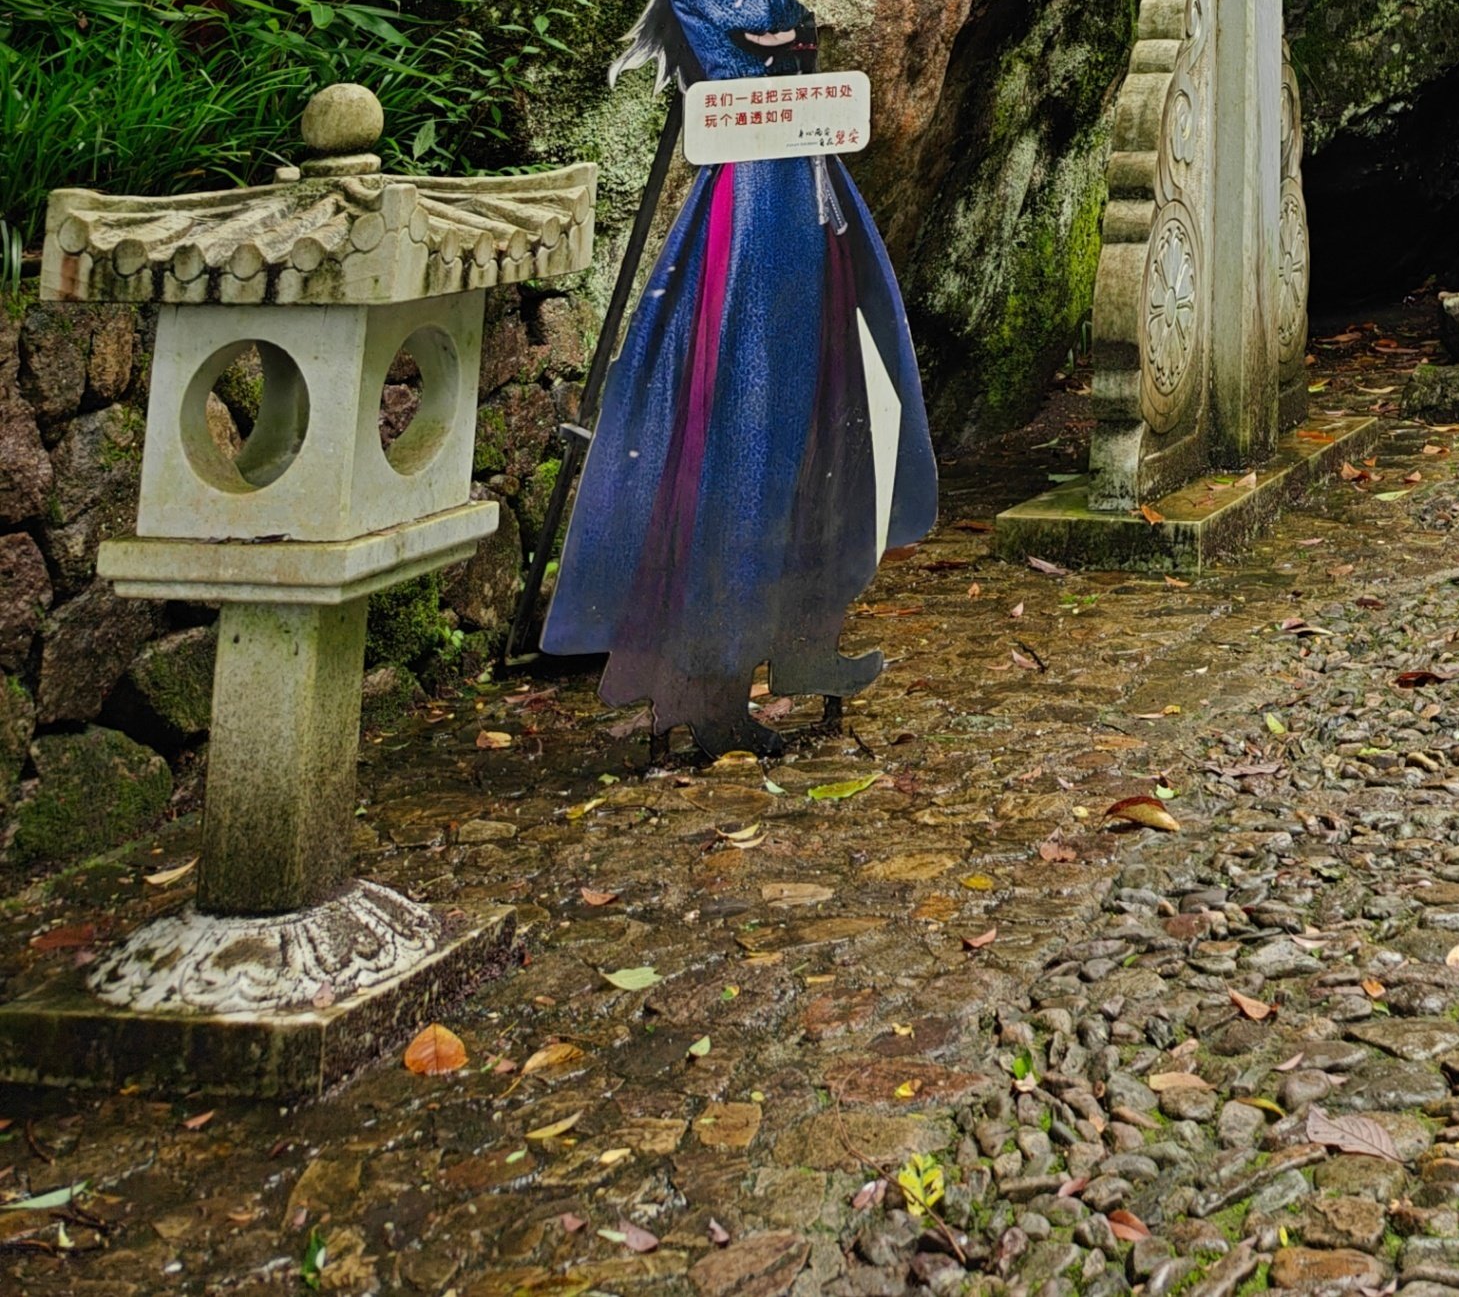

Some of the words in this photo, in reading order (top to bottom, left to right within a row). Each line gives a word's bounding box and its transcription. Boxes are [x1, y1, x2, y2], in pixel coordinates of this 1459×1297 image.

[704, 84, 853, 108] 我们一起把云深不知处
[704, 109, 793, 128] 玩个通透如何
